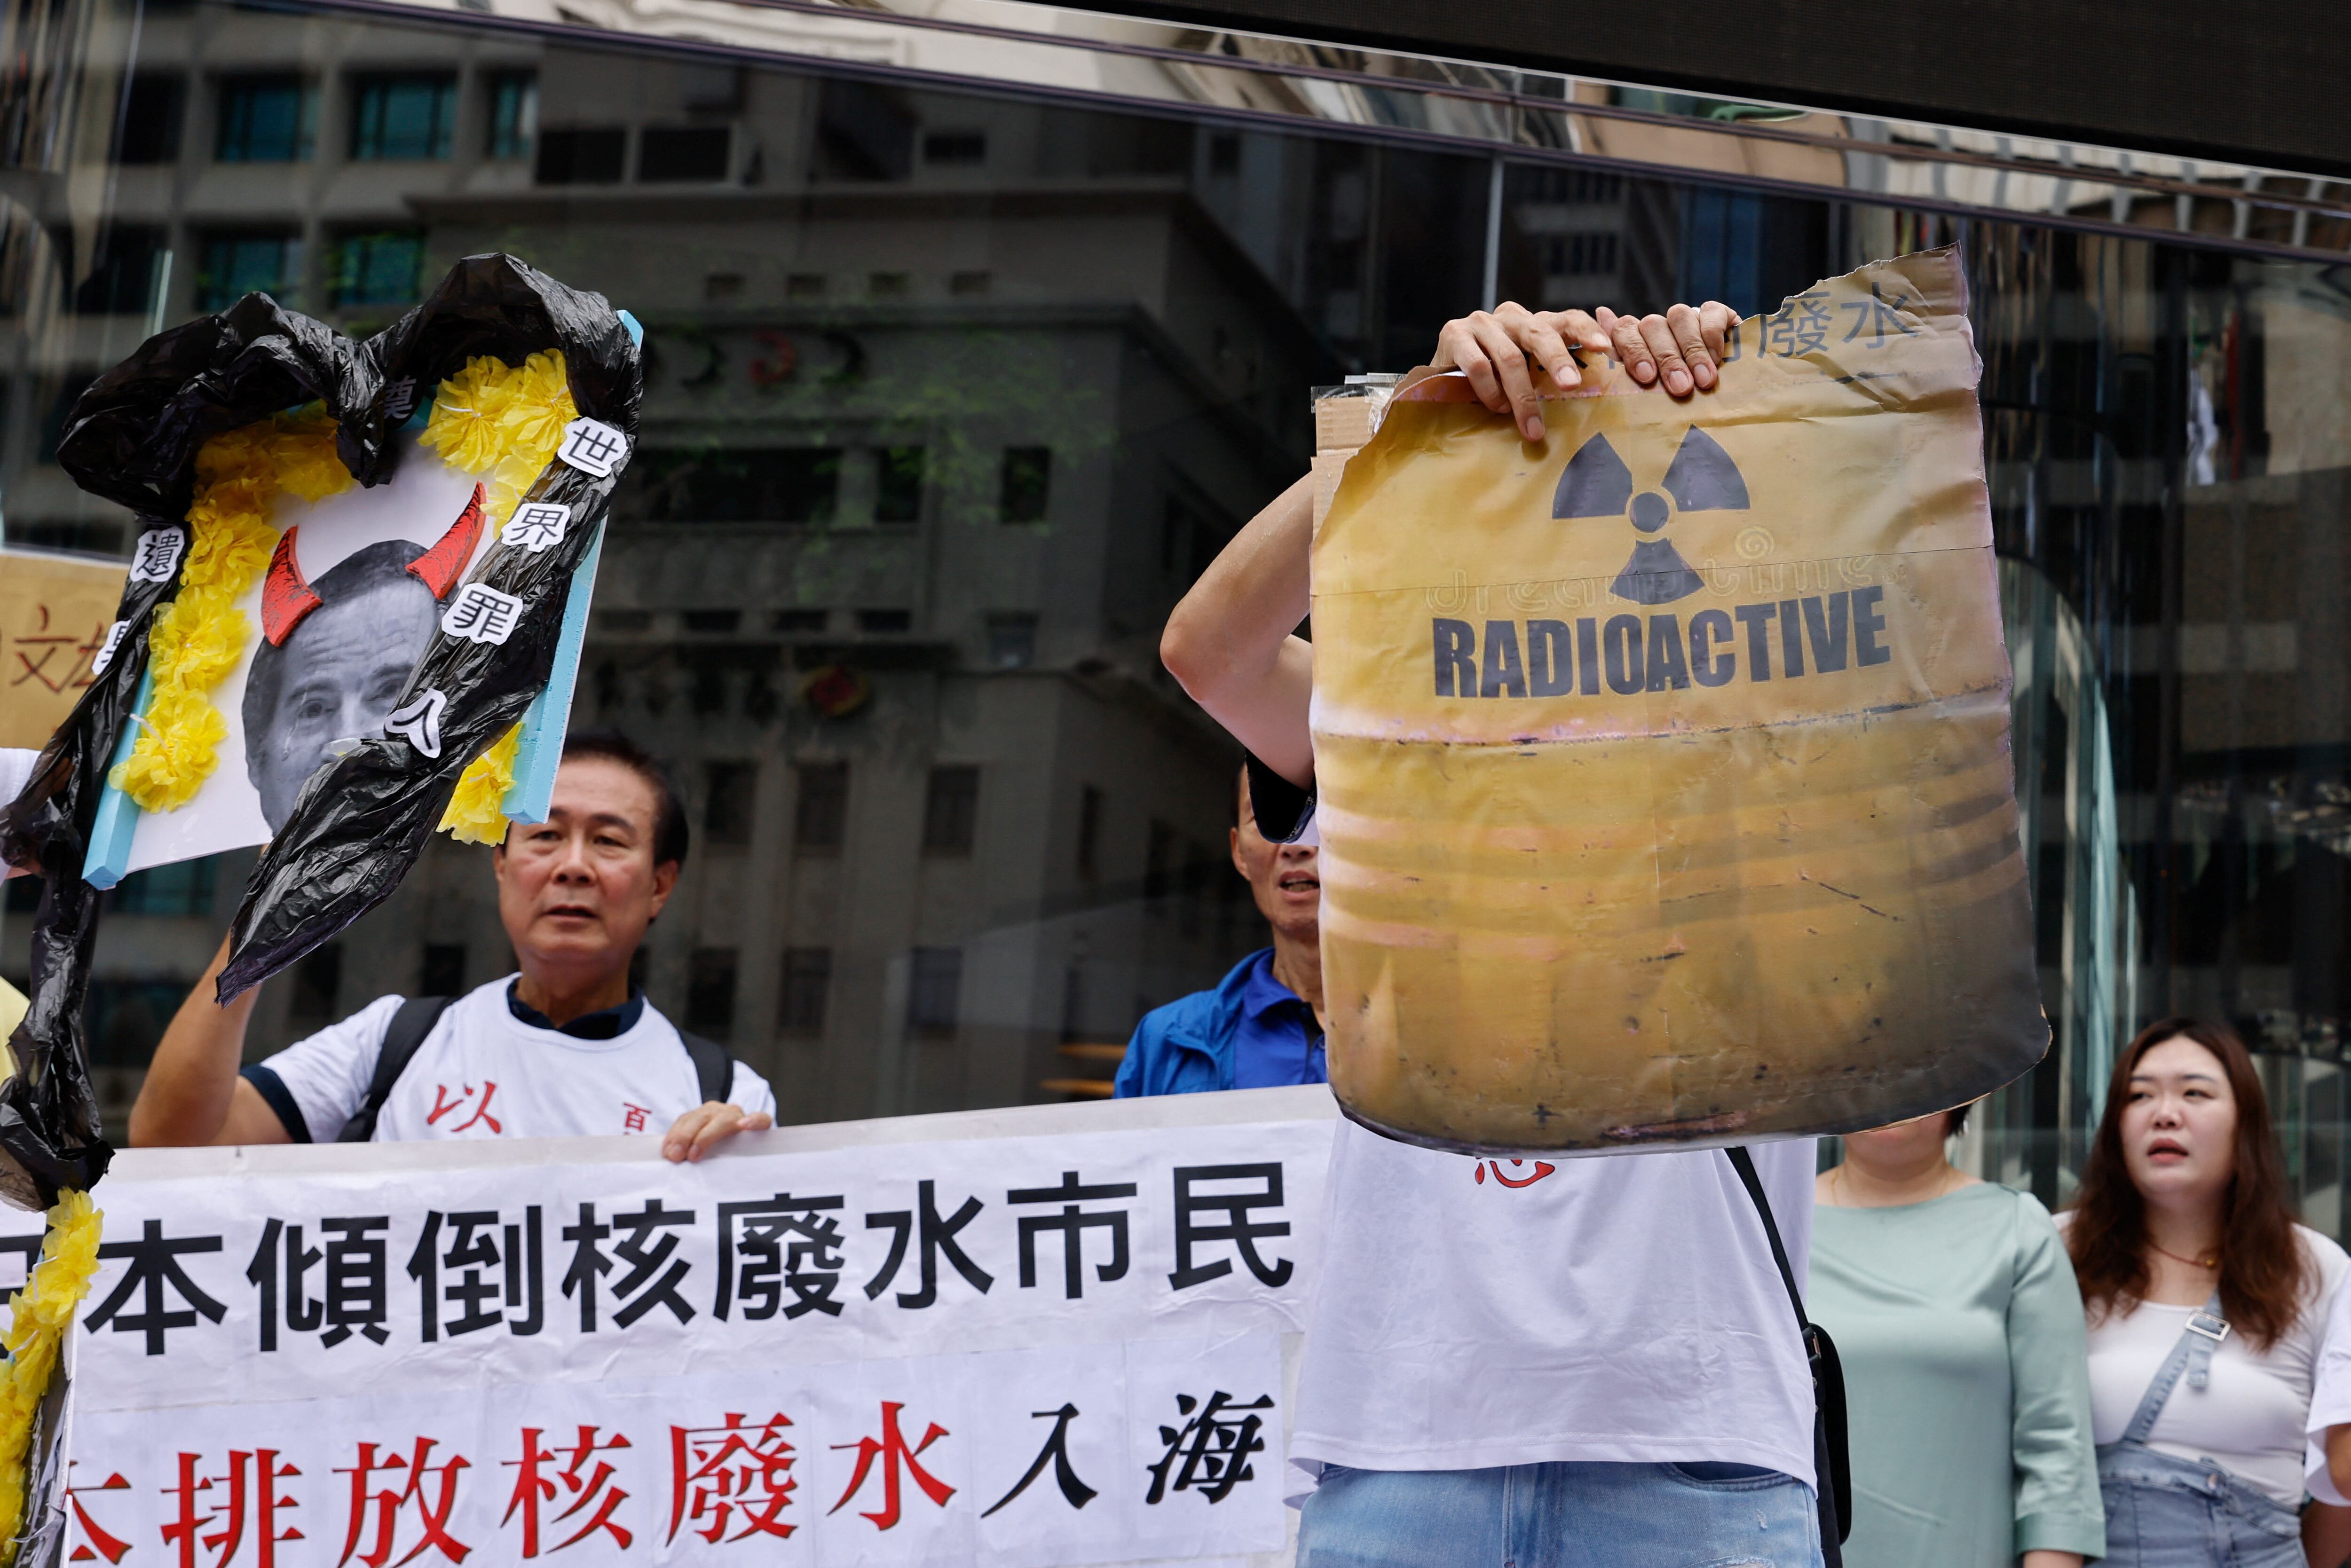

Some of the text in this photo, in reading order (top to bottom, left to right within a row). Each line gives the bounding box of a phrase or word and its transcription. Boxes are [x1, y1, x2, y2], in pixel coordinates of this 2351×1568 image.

[1722, 281, 1921, 362] 廢水
[1432, 585, 1892, 698] RADIOACTIVE
[426, 1081, 503, 1134] 以
